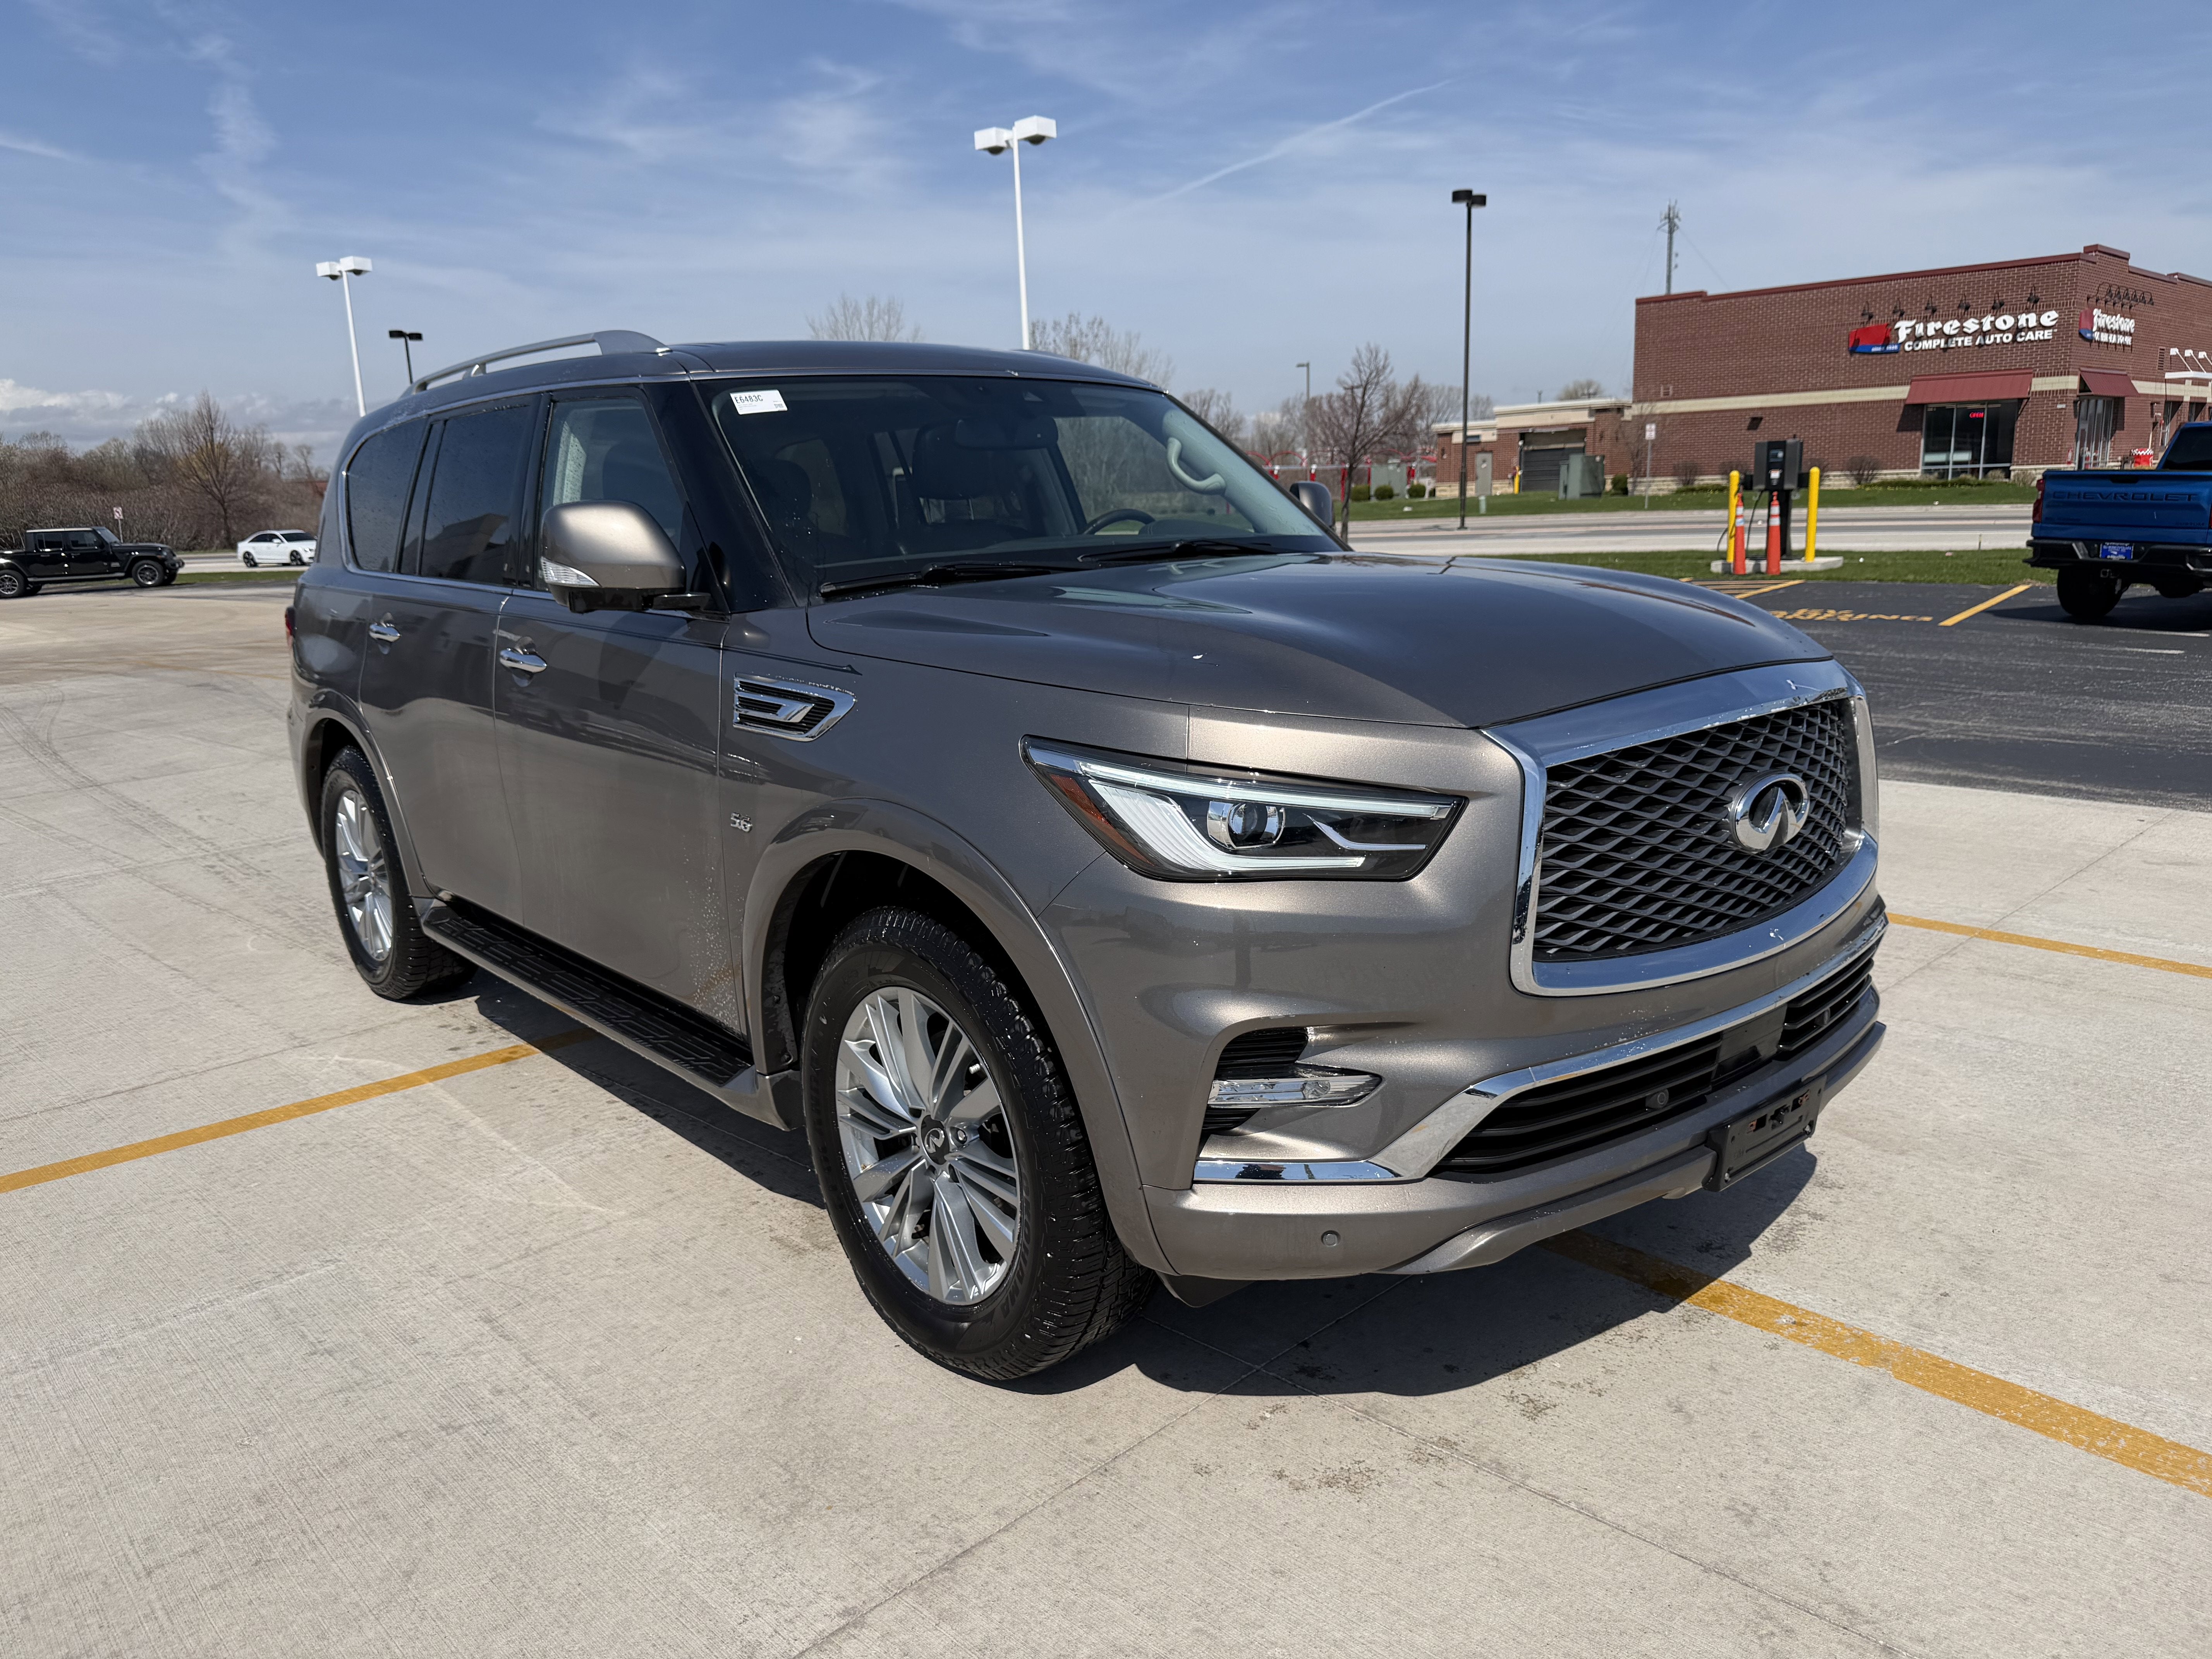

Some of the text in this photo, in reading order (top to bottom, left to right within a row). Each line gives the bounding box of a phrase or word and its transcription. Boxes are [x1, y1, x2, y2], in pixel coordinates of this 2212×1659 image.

[1894, 310, 2059, 343] Firestone
[2093, 308, 2135, 333] Firestone
[1904, 336, 1972, 352] COMPLETE
[1976, 332, 2012, 346] AUTO
[2016, 329, 2053, 342] CARE
[734, 395, 763, 404] E6483C
[2052, 491, 2198, 502] CHEVROLET
